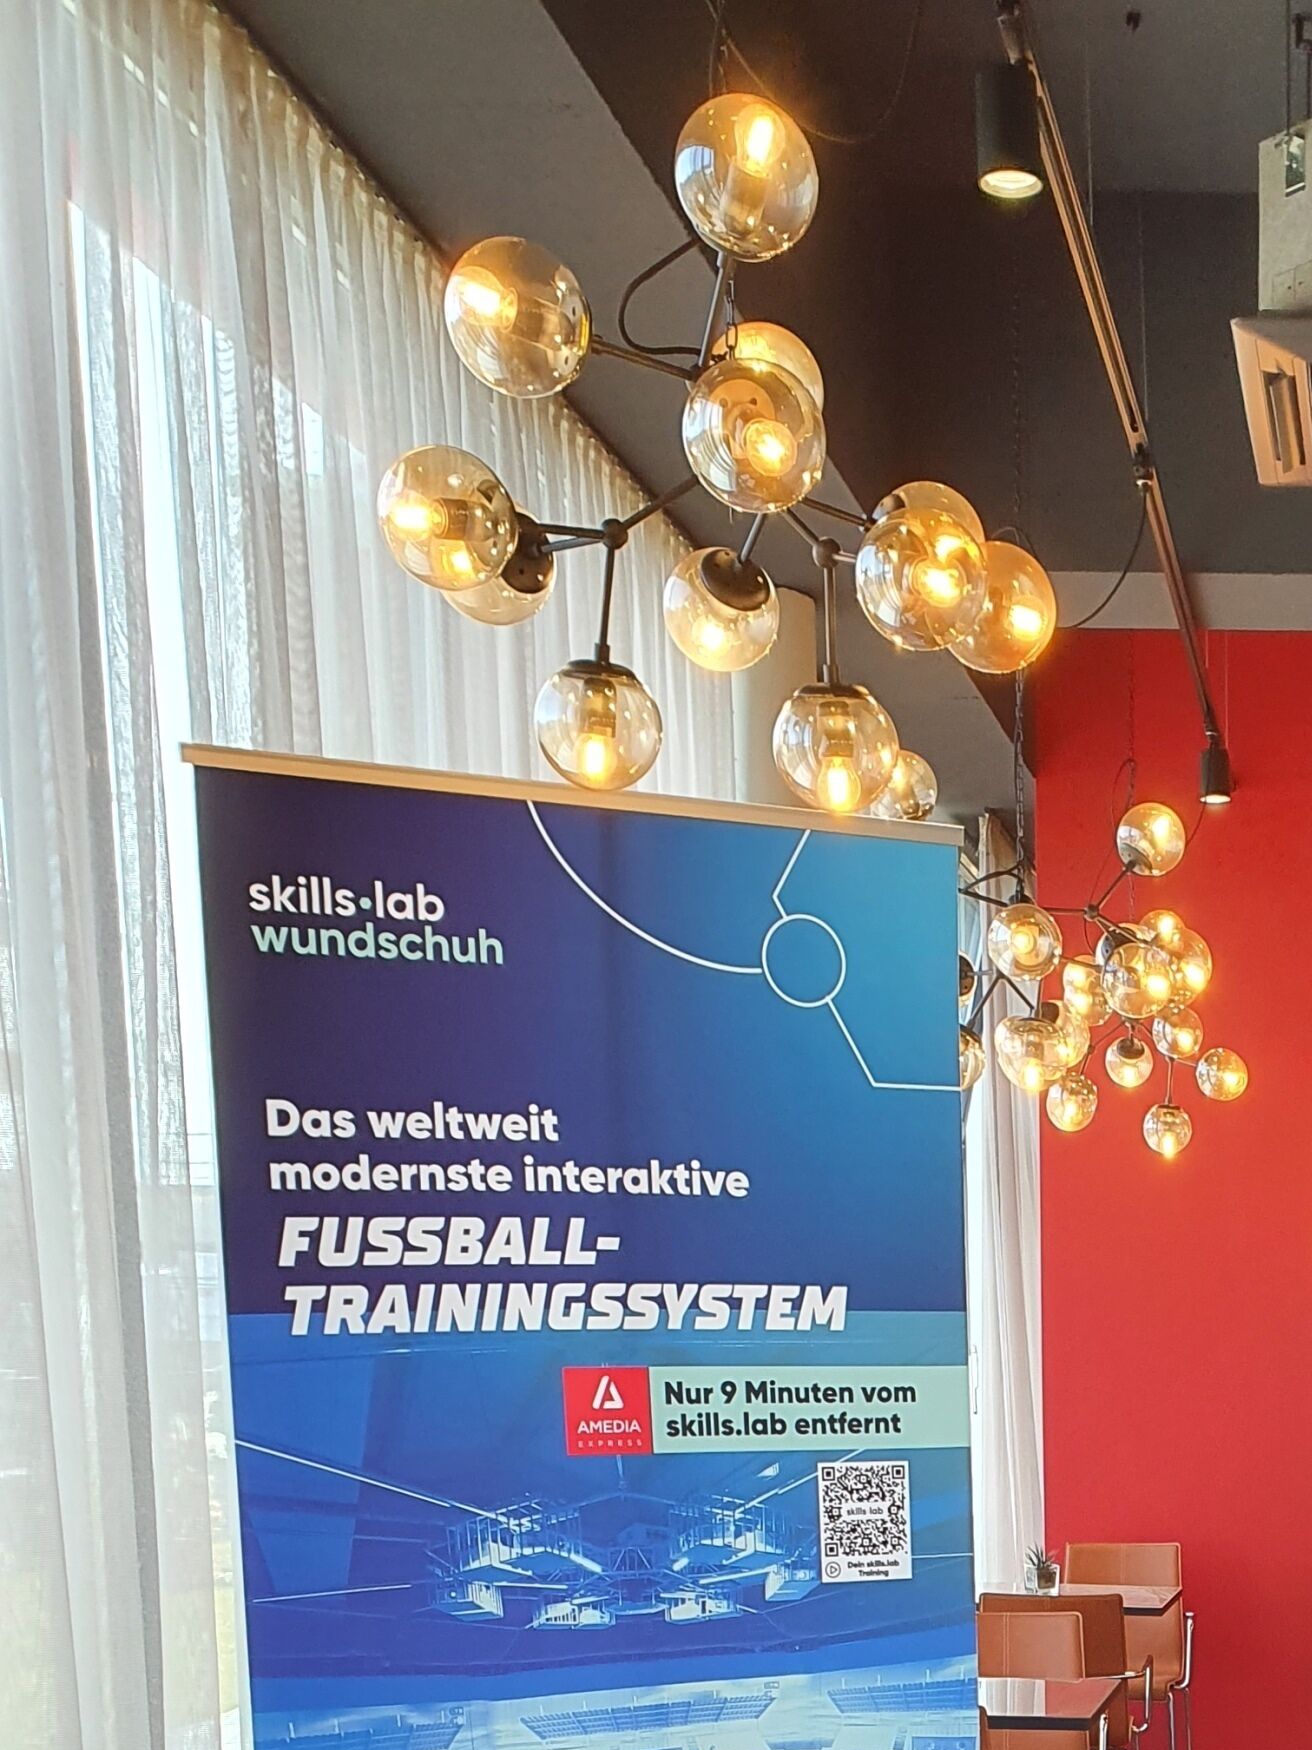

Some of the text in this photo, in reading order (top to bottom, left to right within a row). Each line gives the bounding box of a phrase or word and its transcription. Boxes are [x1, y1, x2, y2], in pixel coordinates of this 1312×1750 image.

[250, 921, 504, 965] wundschuh
[265, 1098, 560, 1142] Das weltweit
[269, 1153, 750, 1198] modernste interaktive
[278, 1216, 621, 1268] FUSSBALL-
[284, 1282, 848, 1335] TRAININGSSYSTEM
[664, 1379, 917, 1405] Nur 9 Minuten vom
[577, 1419, 641, 1434] AMEDIA
[666, 1411, 902, 1437] skills.lab entfernt
[577, 1439, 643, 1448] EXPRESS
[847, 1560, 865, 1569] Dein
[858, 1568, 889, 1577] Training
